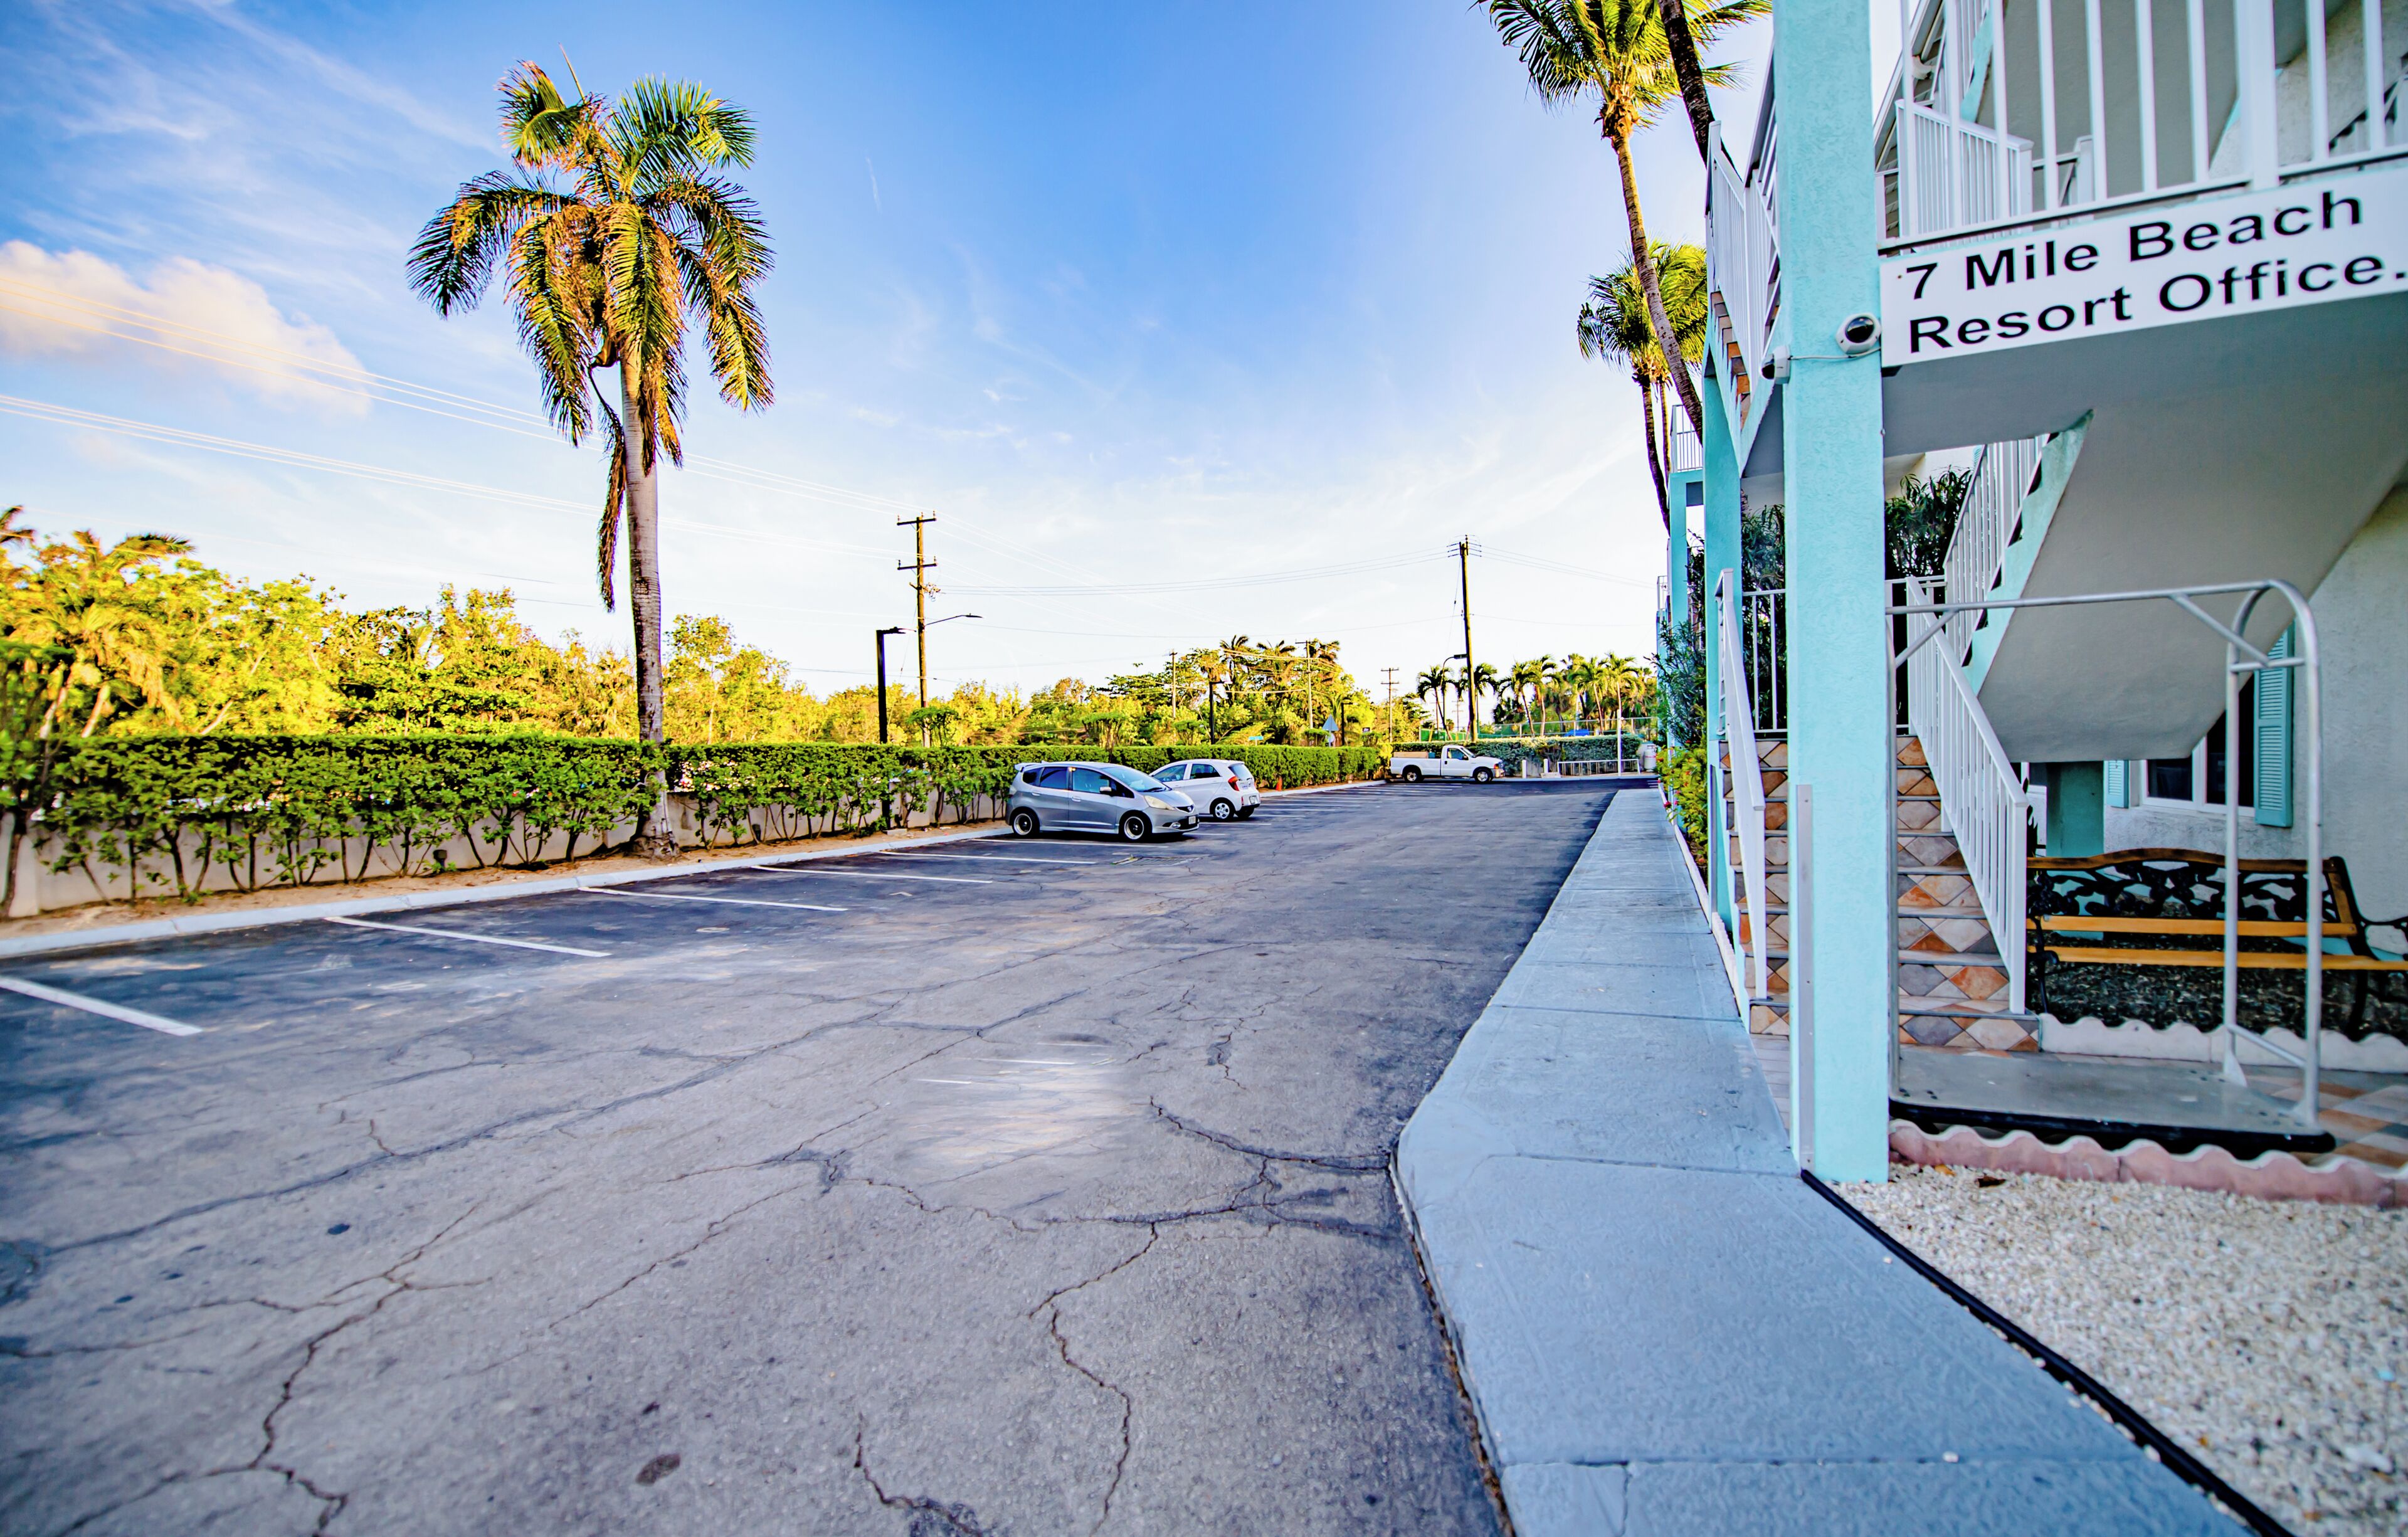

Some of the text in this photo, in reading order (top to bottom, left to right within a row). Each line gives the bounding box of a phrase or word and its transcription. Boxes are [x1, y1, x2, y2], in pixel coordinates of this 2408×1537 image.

[1906, 191, 2362, 300] 7 Mile Beach
[1909, 255, 2407, 354] Resort Office.
